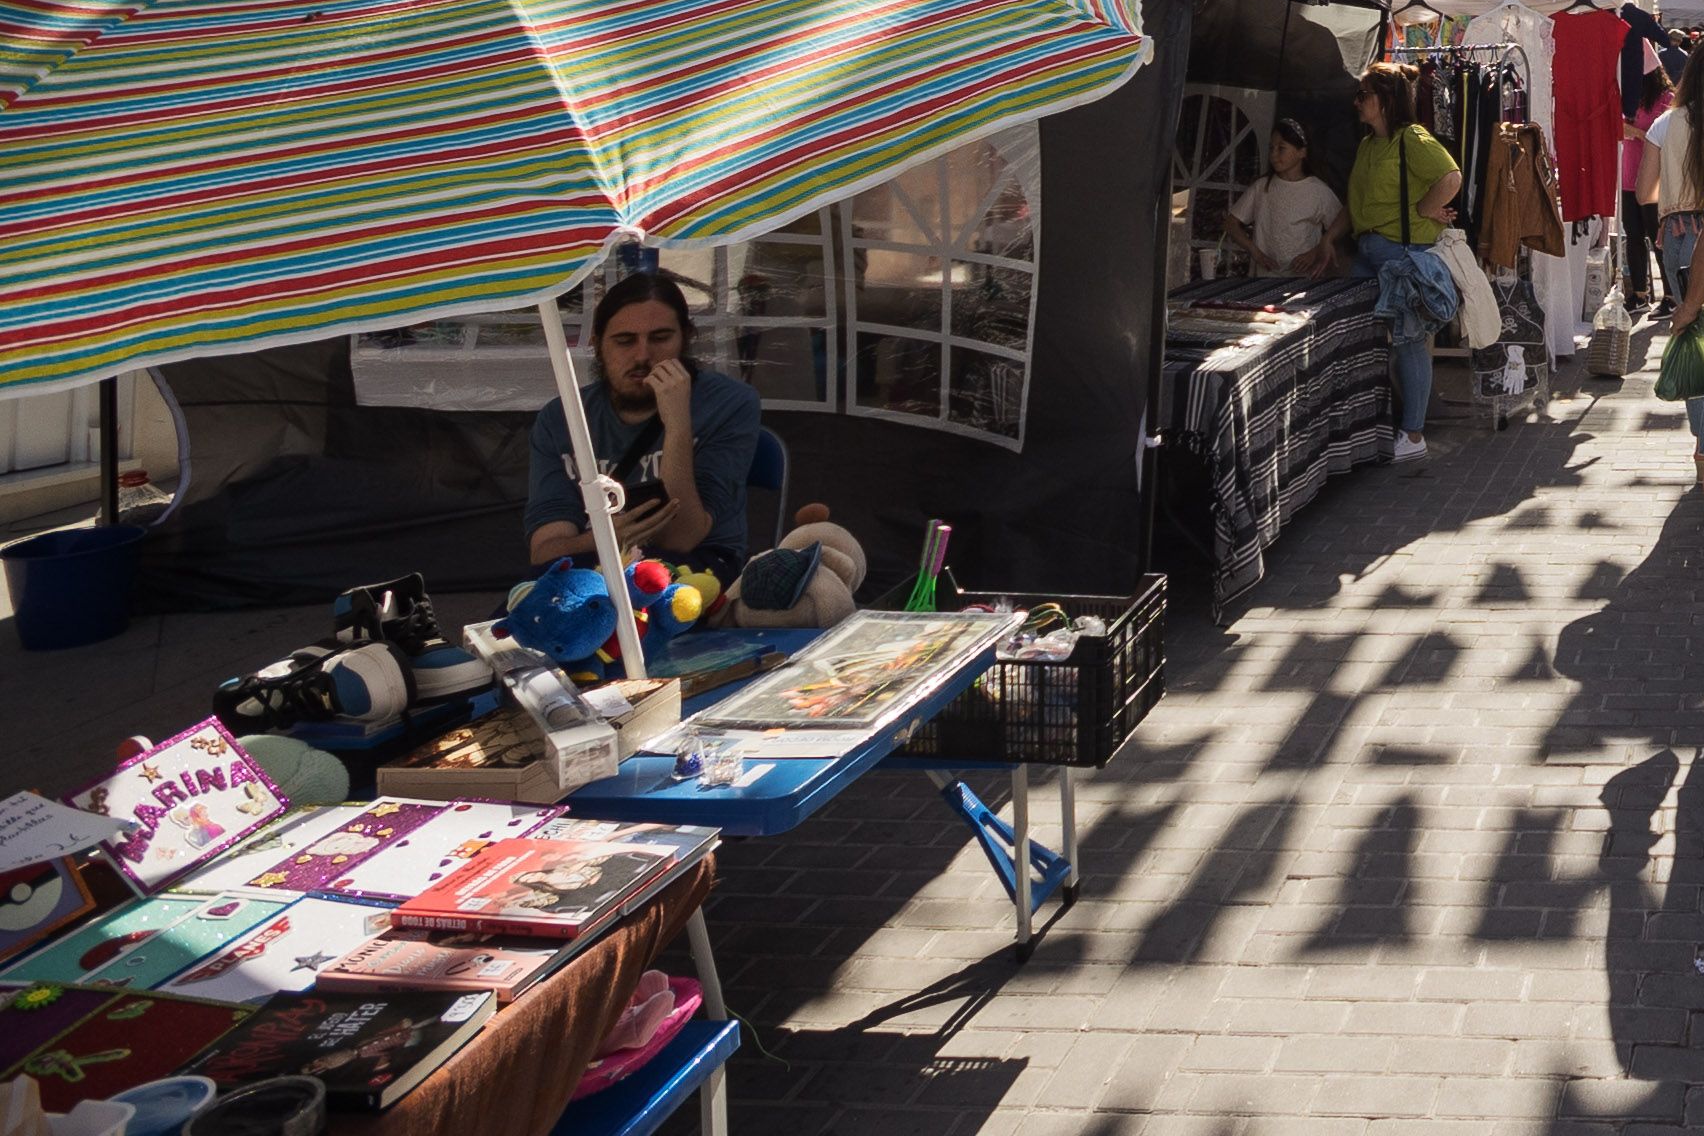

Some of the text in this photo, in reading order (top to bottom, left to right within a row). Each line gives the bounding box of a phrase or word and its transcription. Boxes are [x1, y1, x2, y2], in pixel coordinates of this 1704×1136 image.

[115, 760, 258, 863] MARINA
[213, 926, 283, 970] PLANES
[329, 1002, 388, 1036] HATER
